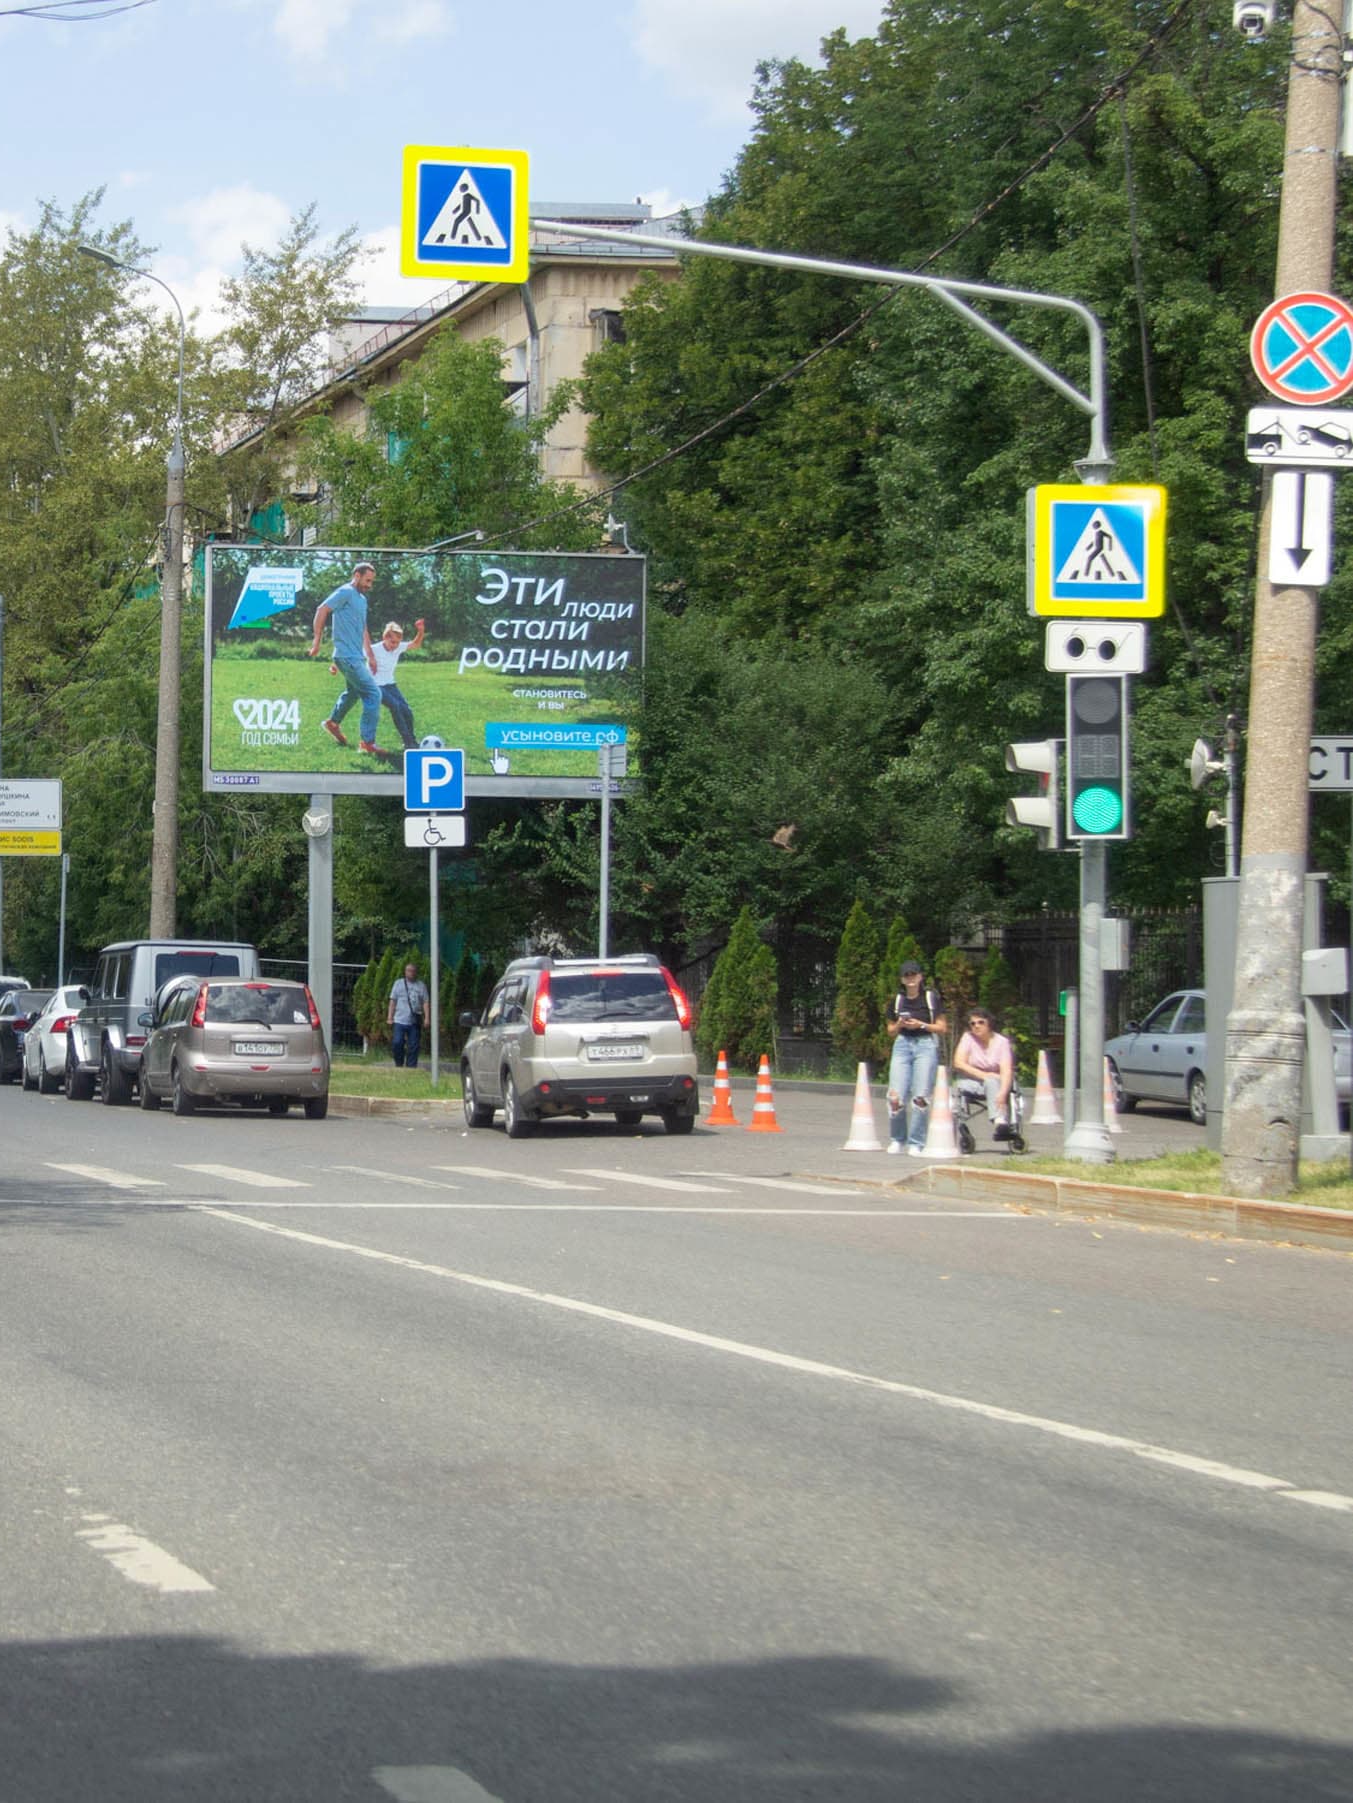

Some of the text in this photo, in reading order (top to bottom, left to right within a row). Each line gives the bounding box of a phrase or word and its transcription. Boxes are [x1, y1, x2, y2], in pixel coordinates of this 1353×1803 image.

[476, 568, 634, 621] Эти люди
[490, 619, 590, 641] стали
[457, 647, 629, 675] родными
[512, 689, 587, 699] СТАНОВИТЕСЬ
[233, 698, 301, 731] 2024
[537, 701, 565, 710] И ВЫ
[241, 732, 261, 747] ГОД
[501, 729, 619, 746] усыновите.рф
[421, 756, 454, 804] P
